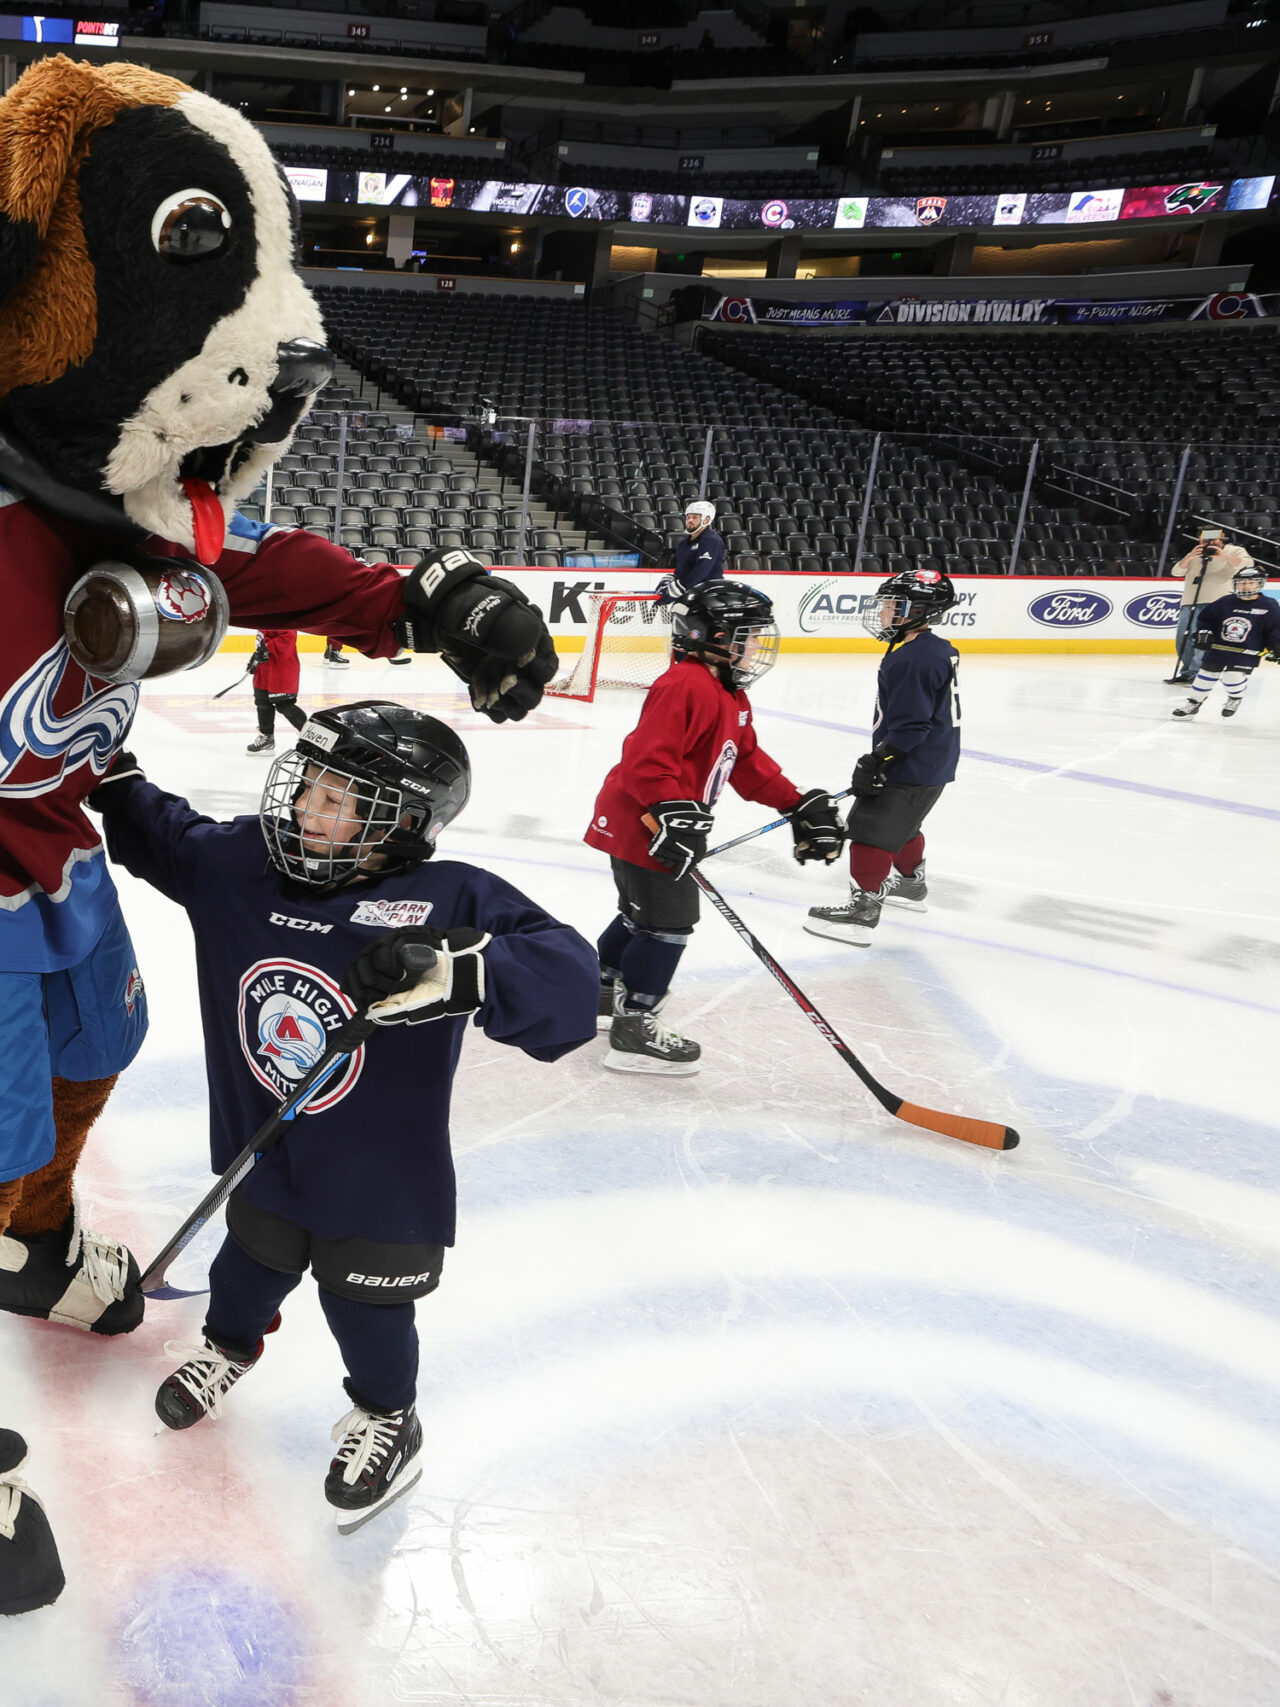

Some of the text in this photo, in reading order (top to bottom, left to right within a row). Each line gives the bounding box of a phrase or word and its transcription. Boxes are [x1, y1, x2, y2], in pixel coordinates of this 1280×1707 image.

[682, 159, 700, 169] 236
[766, 307, 851, 321] JUST MEANS MORE
[896, 303, 1046, 323] DIVISION RIVALRY
[1128, 304, 1168, 316] NIGHT
[811, 593, 879, 614] ACP
[1043, 595, 1097, 622] Ford
[302, 724, 329, 748] Haven
[399, 777, 432, 795] CCM
[669, 818, 713, 831] CC
[385, 902, 427, 913] LEARN
[268, 912, 336, 935] CCM
[389, 912, 425, 924] PLAY
[249, 975, 344, 1031] MILE HIGH
[806, 1011, 843, 1046] CCM
[264, 1061, 298, 1094] MIT
[345, 1271, 430, 1288] BAUER
